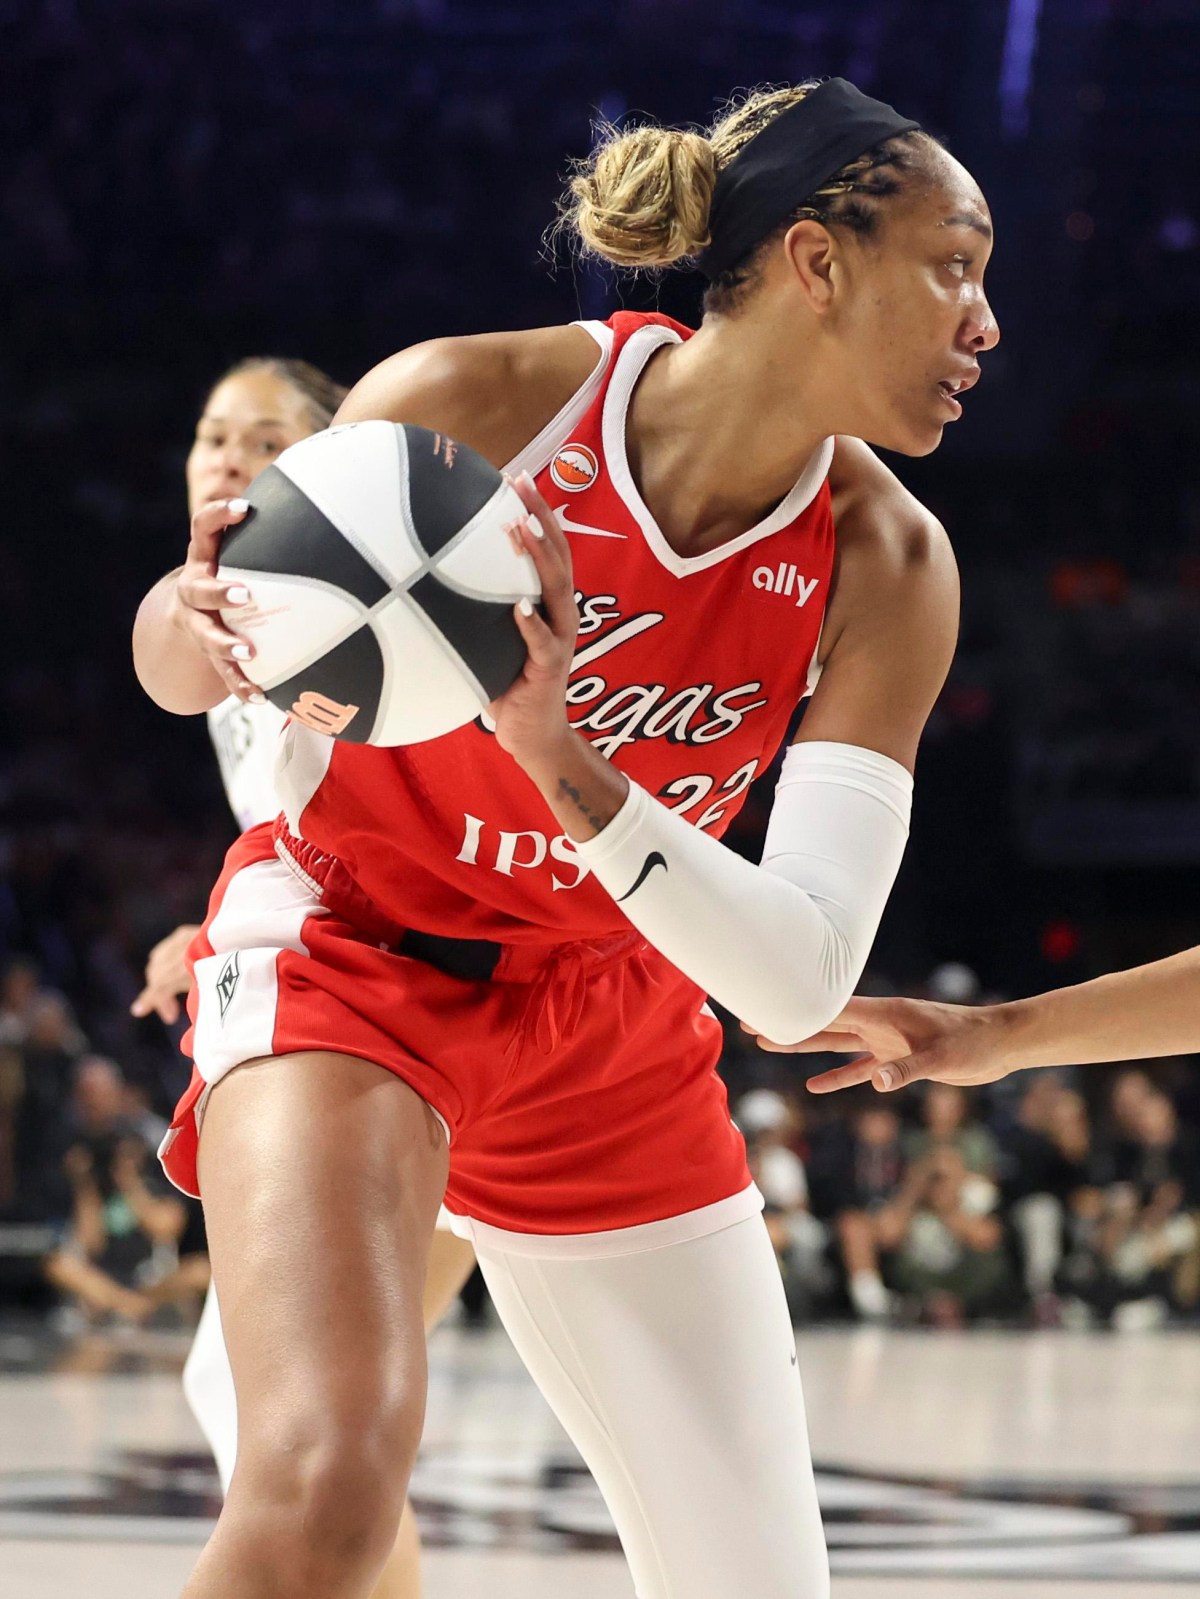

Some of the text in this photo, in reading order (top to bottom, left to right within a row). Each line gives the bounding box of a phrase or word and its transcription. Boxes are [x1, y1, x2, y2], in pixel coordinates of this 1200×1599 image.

[752, 562, 819, 607] ally
[661, 758, 759, 829] 22
[455, 813, 591, 892] IPS
